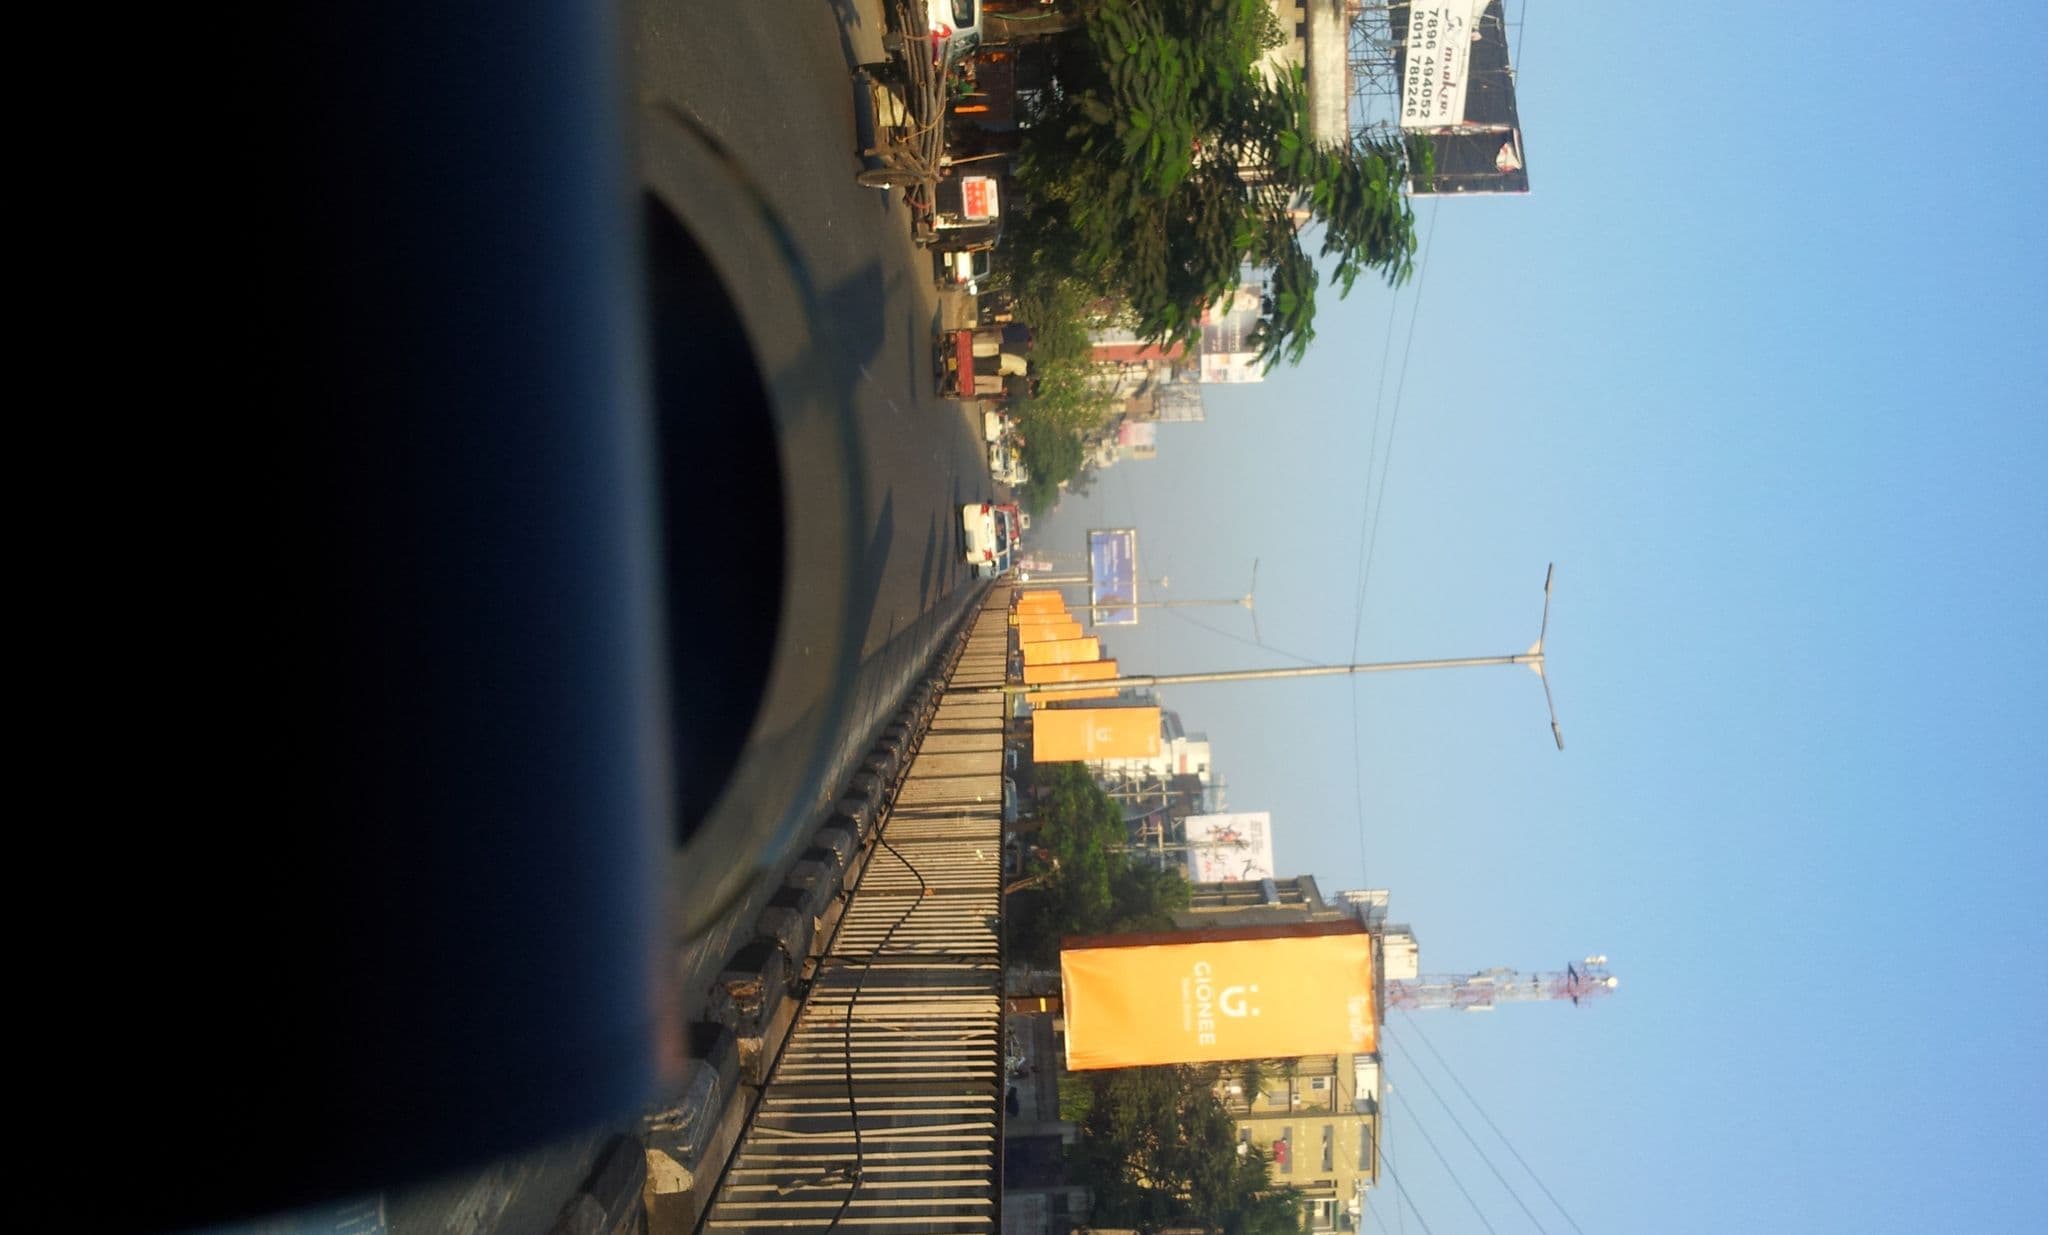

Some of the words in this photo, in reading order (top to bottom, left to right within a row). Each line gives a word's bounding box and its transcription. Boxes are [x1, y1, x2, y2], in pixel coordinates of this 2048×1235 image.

[1410, 10, 1424, 48] 8011
[1426, 8, 1439, 49] 7896
[1406, 56, 1420, 118] 788246
[1420, 56, 1434, 118] 494052
[1194, 961, 1216, 1046] GIONEE
